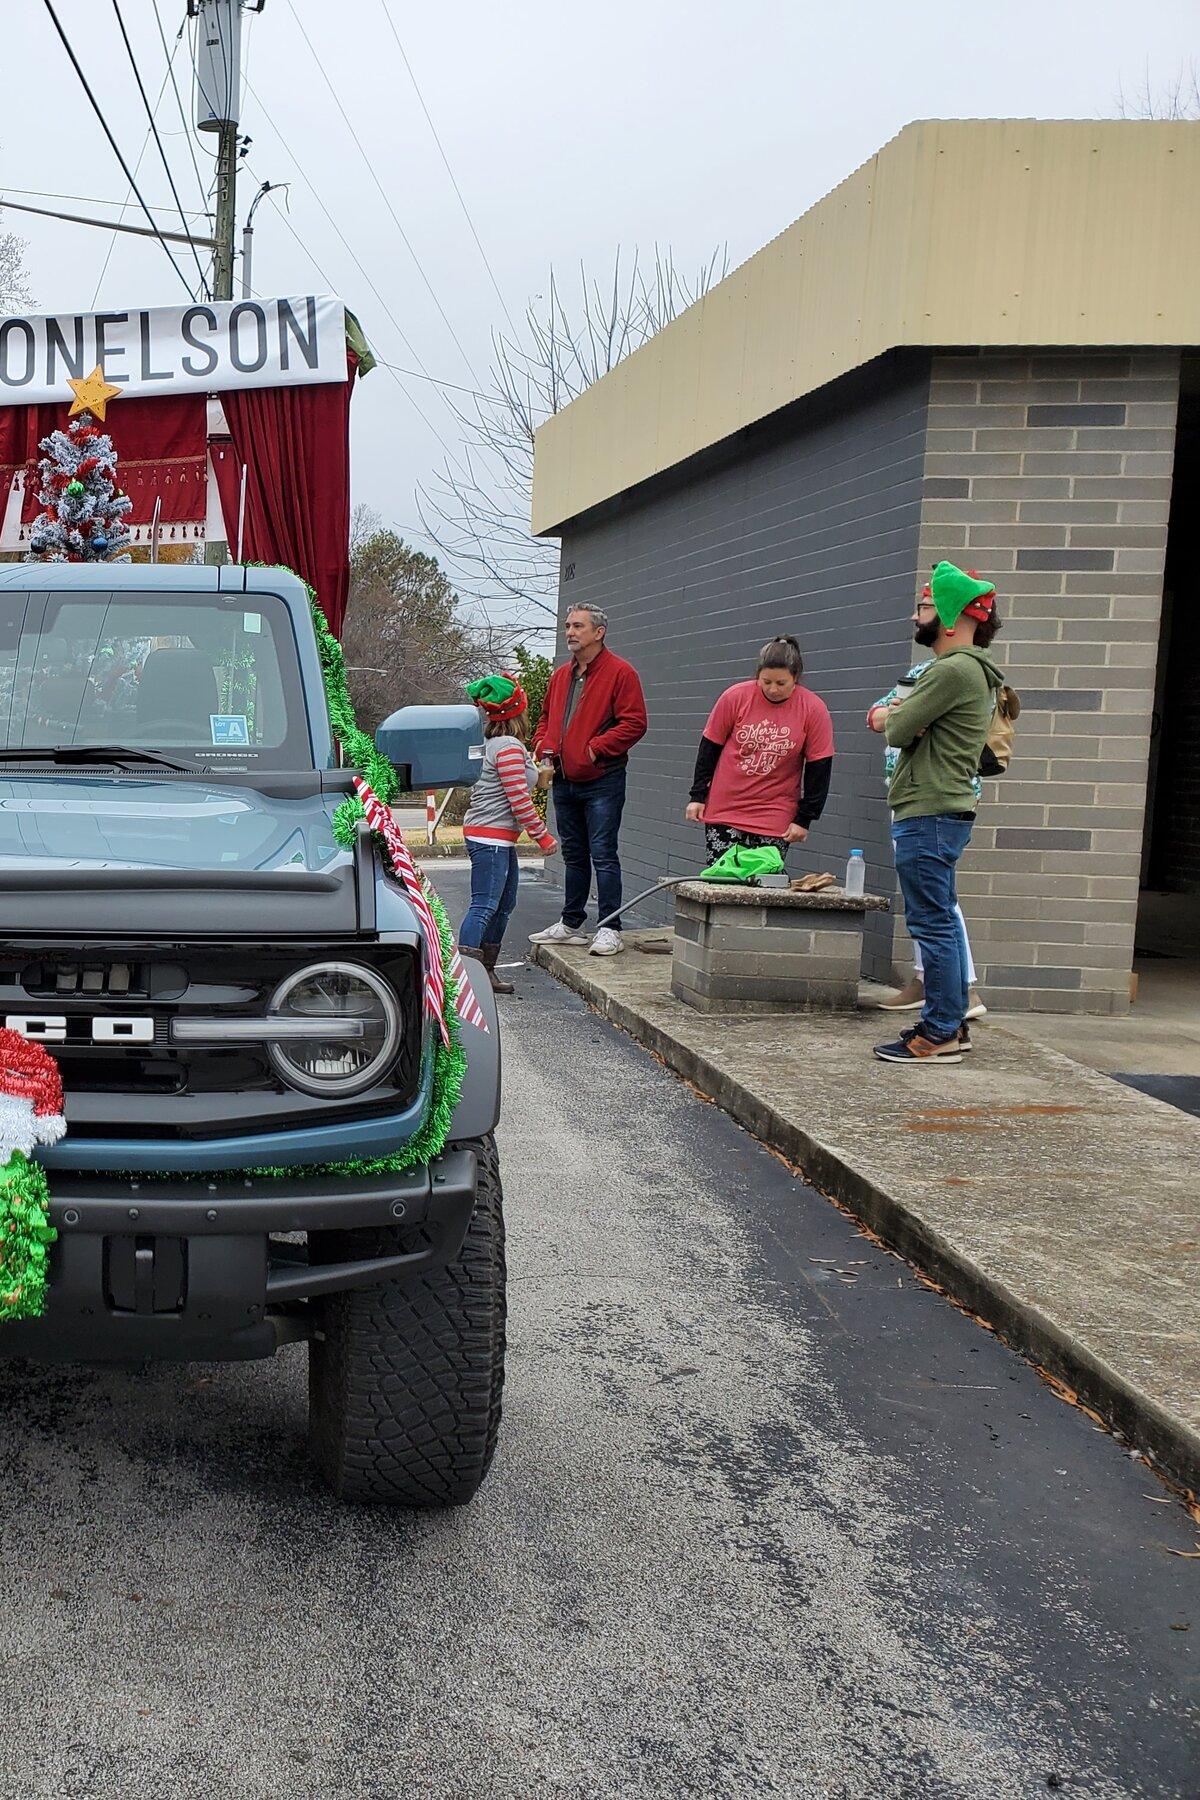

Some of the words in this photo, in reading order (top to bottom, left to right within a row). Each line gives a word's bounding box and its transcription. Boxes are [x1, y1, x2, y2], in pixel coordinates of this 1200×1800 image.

[228, 722, 243, 737] A
[736, 723, 791, 744] Merry
[739, 739, 797, 758] Christmas
